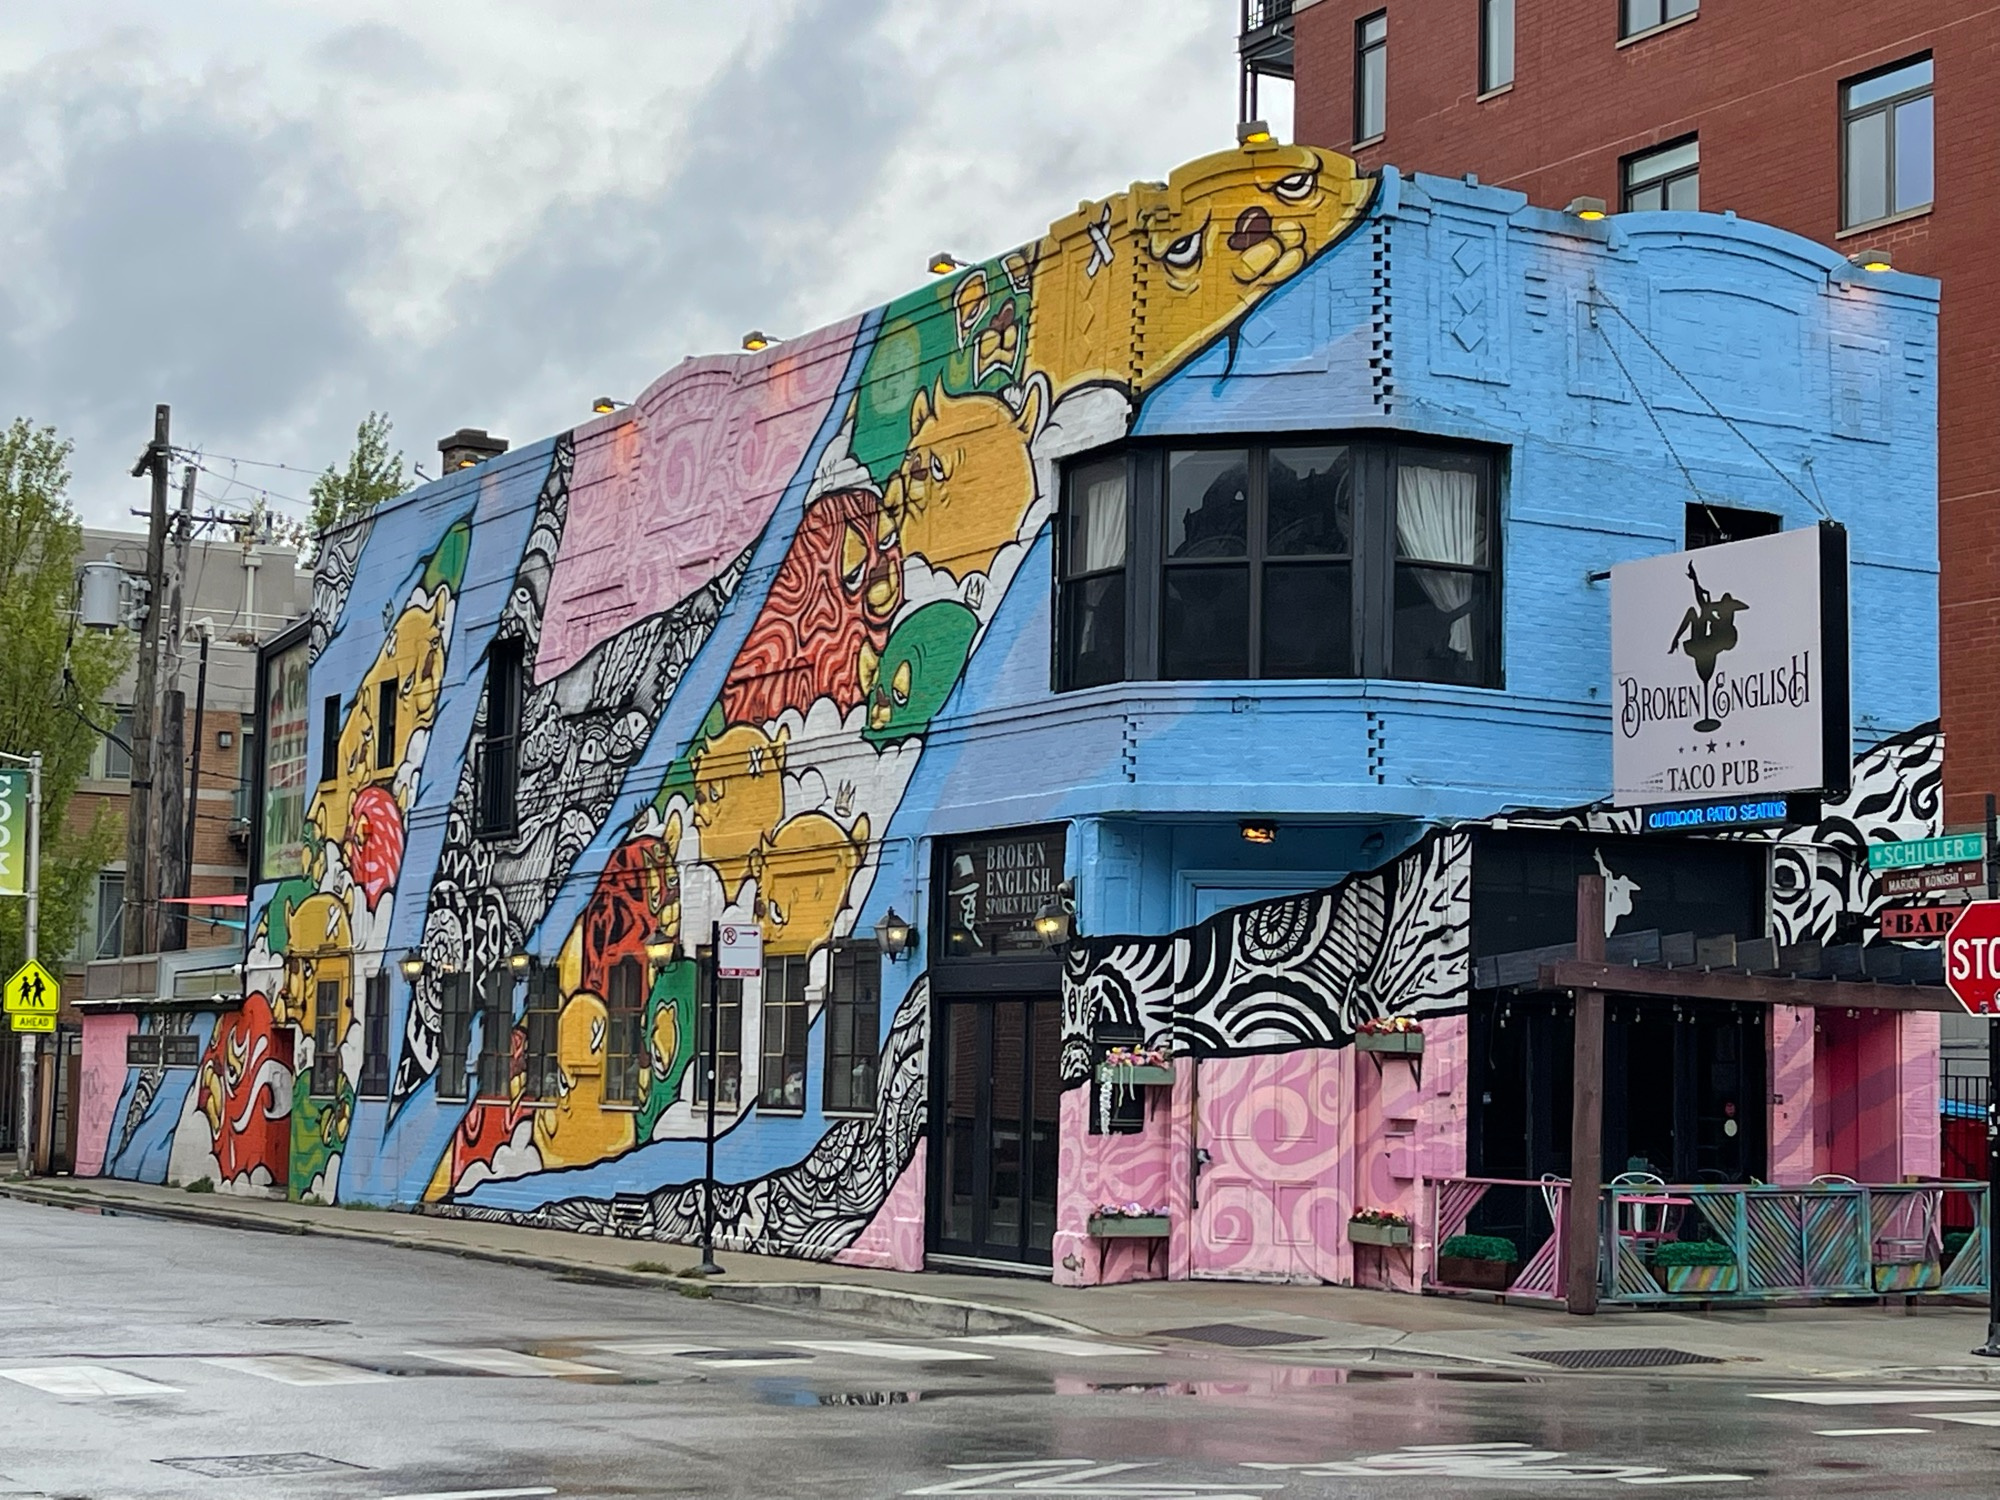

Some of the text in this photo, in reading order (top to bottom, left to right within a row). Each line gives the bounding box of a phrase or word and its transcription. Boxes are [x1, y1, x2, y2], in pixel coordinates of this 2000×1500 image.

[1667, 759, 1760, 792] TACO PUB
[1649, 808, 1705, 829] OUTDOOR
[1706, 805, 1737, 823] PATIO
[986, 842, 1046, 870] BROKEN
[1884, 839, 1965, 865] SCHILLER
[1968, 841, 1979, 853] ST
[1888, 877, 1921, 892] MARION
[985, 895, 1020, 916] SPOKEN
[1895, 911, 1954, 934] BAR
[1952, 936, 2000, 981] STO
[19, 1016, 50, 1027] AHEAD
